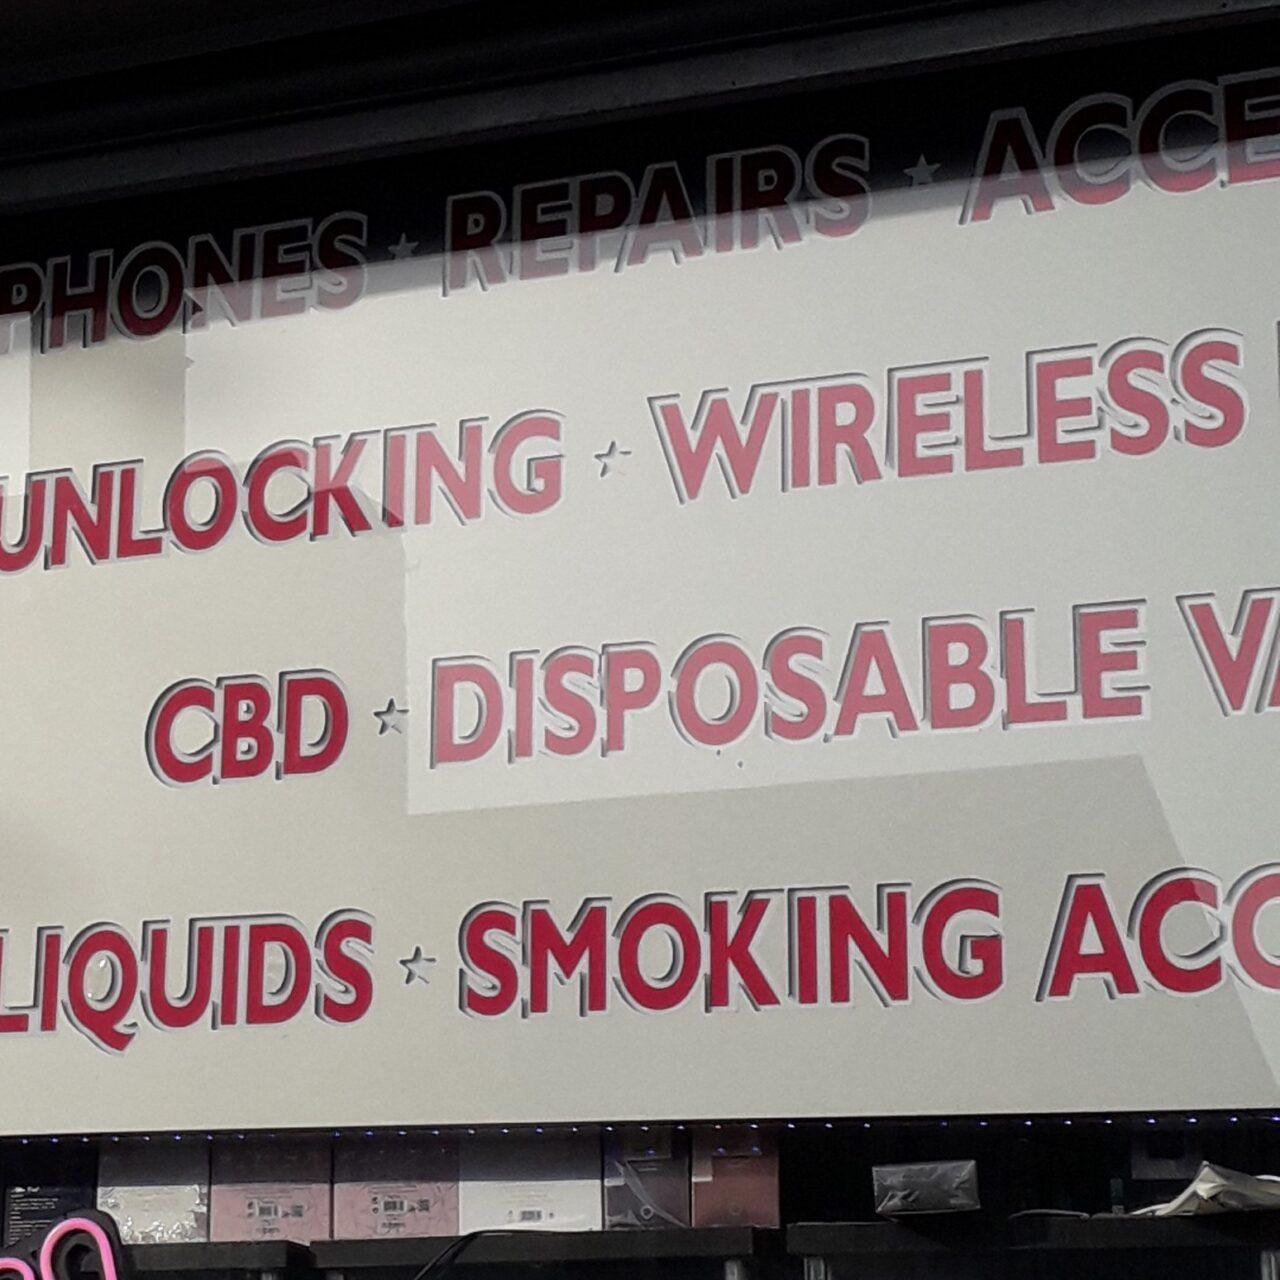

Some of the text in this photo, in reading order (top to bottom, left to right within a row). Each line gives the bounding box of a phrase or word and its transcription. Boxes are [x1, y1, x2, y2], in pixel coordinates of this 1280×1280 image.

[443, 133, 873, 297] REPAIRS
[646, 327, 1249, 505] WIRELESS
[144, 586, 1280, 789] CBD DISPOSABLE V
[458, 877, 1004, 1019] SMOKING
